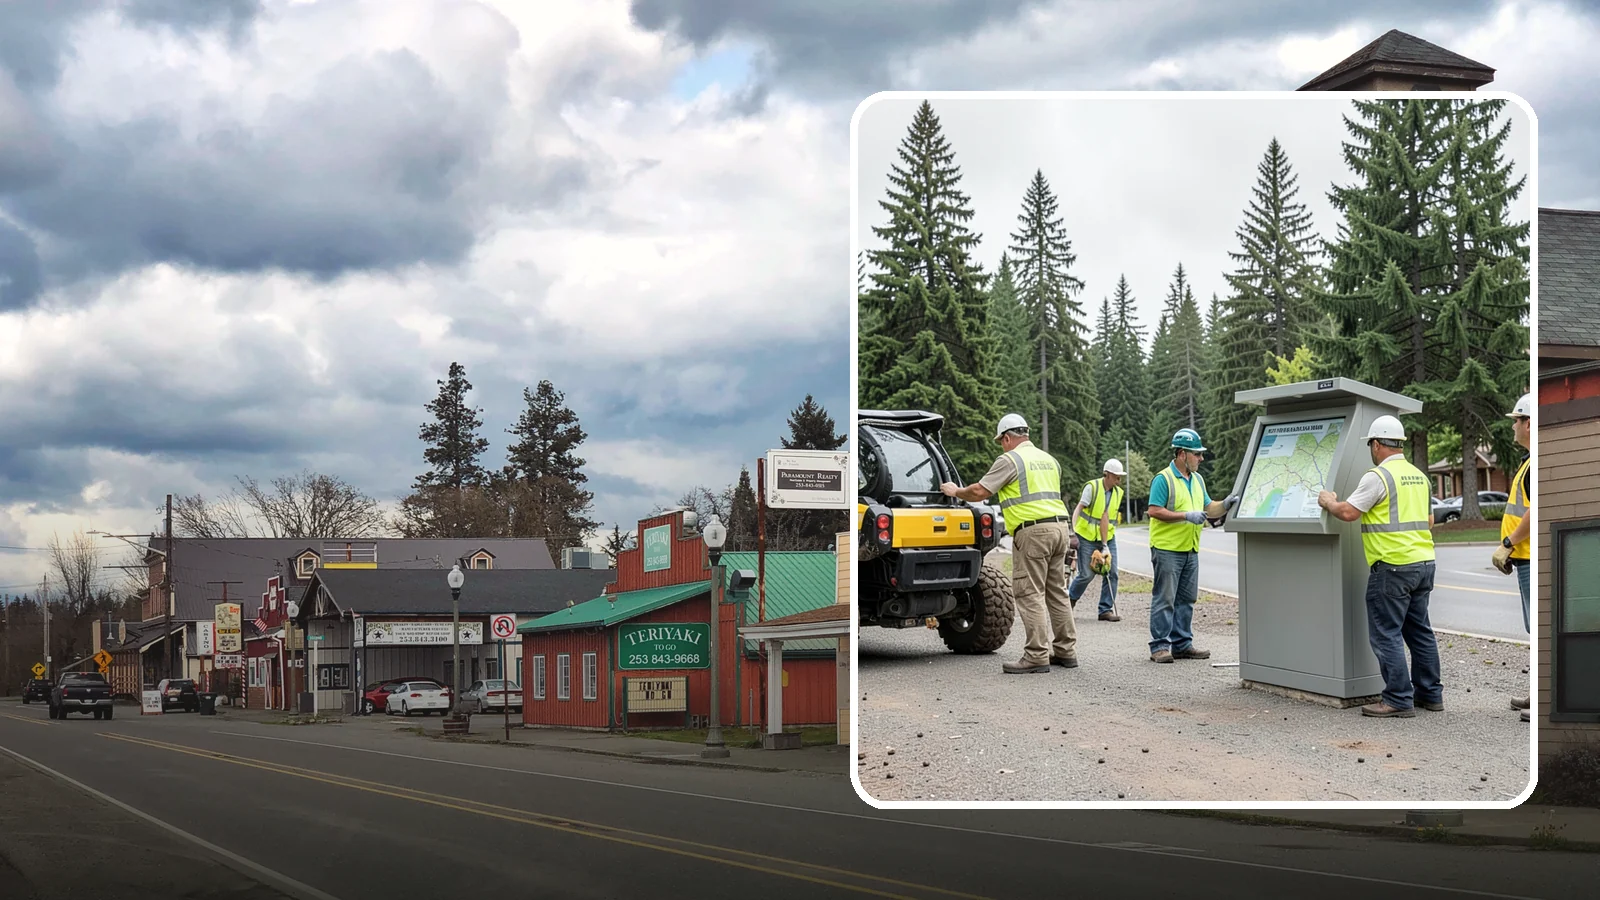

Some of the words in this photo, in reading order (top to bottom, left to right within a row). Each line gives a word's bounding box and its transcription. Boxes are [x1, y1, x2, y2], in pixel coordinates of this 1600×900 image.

[625, 627, 702, 646] TERIYAKI
[629, 654, 648, 664] 253
[651, 654, 700, 664] 843-9668
